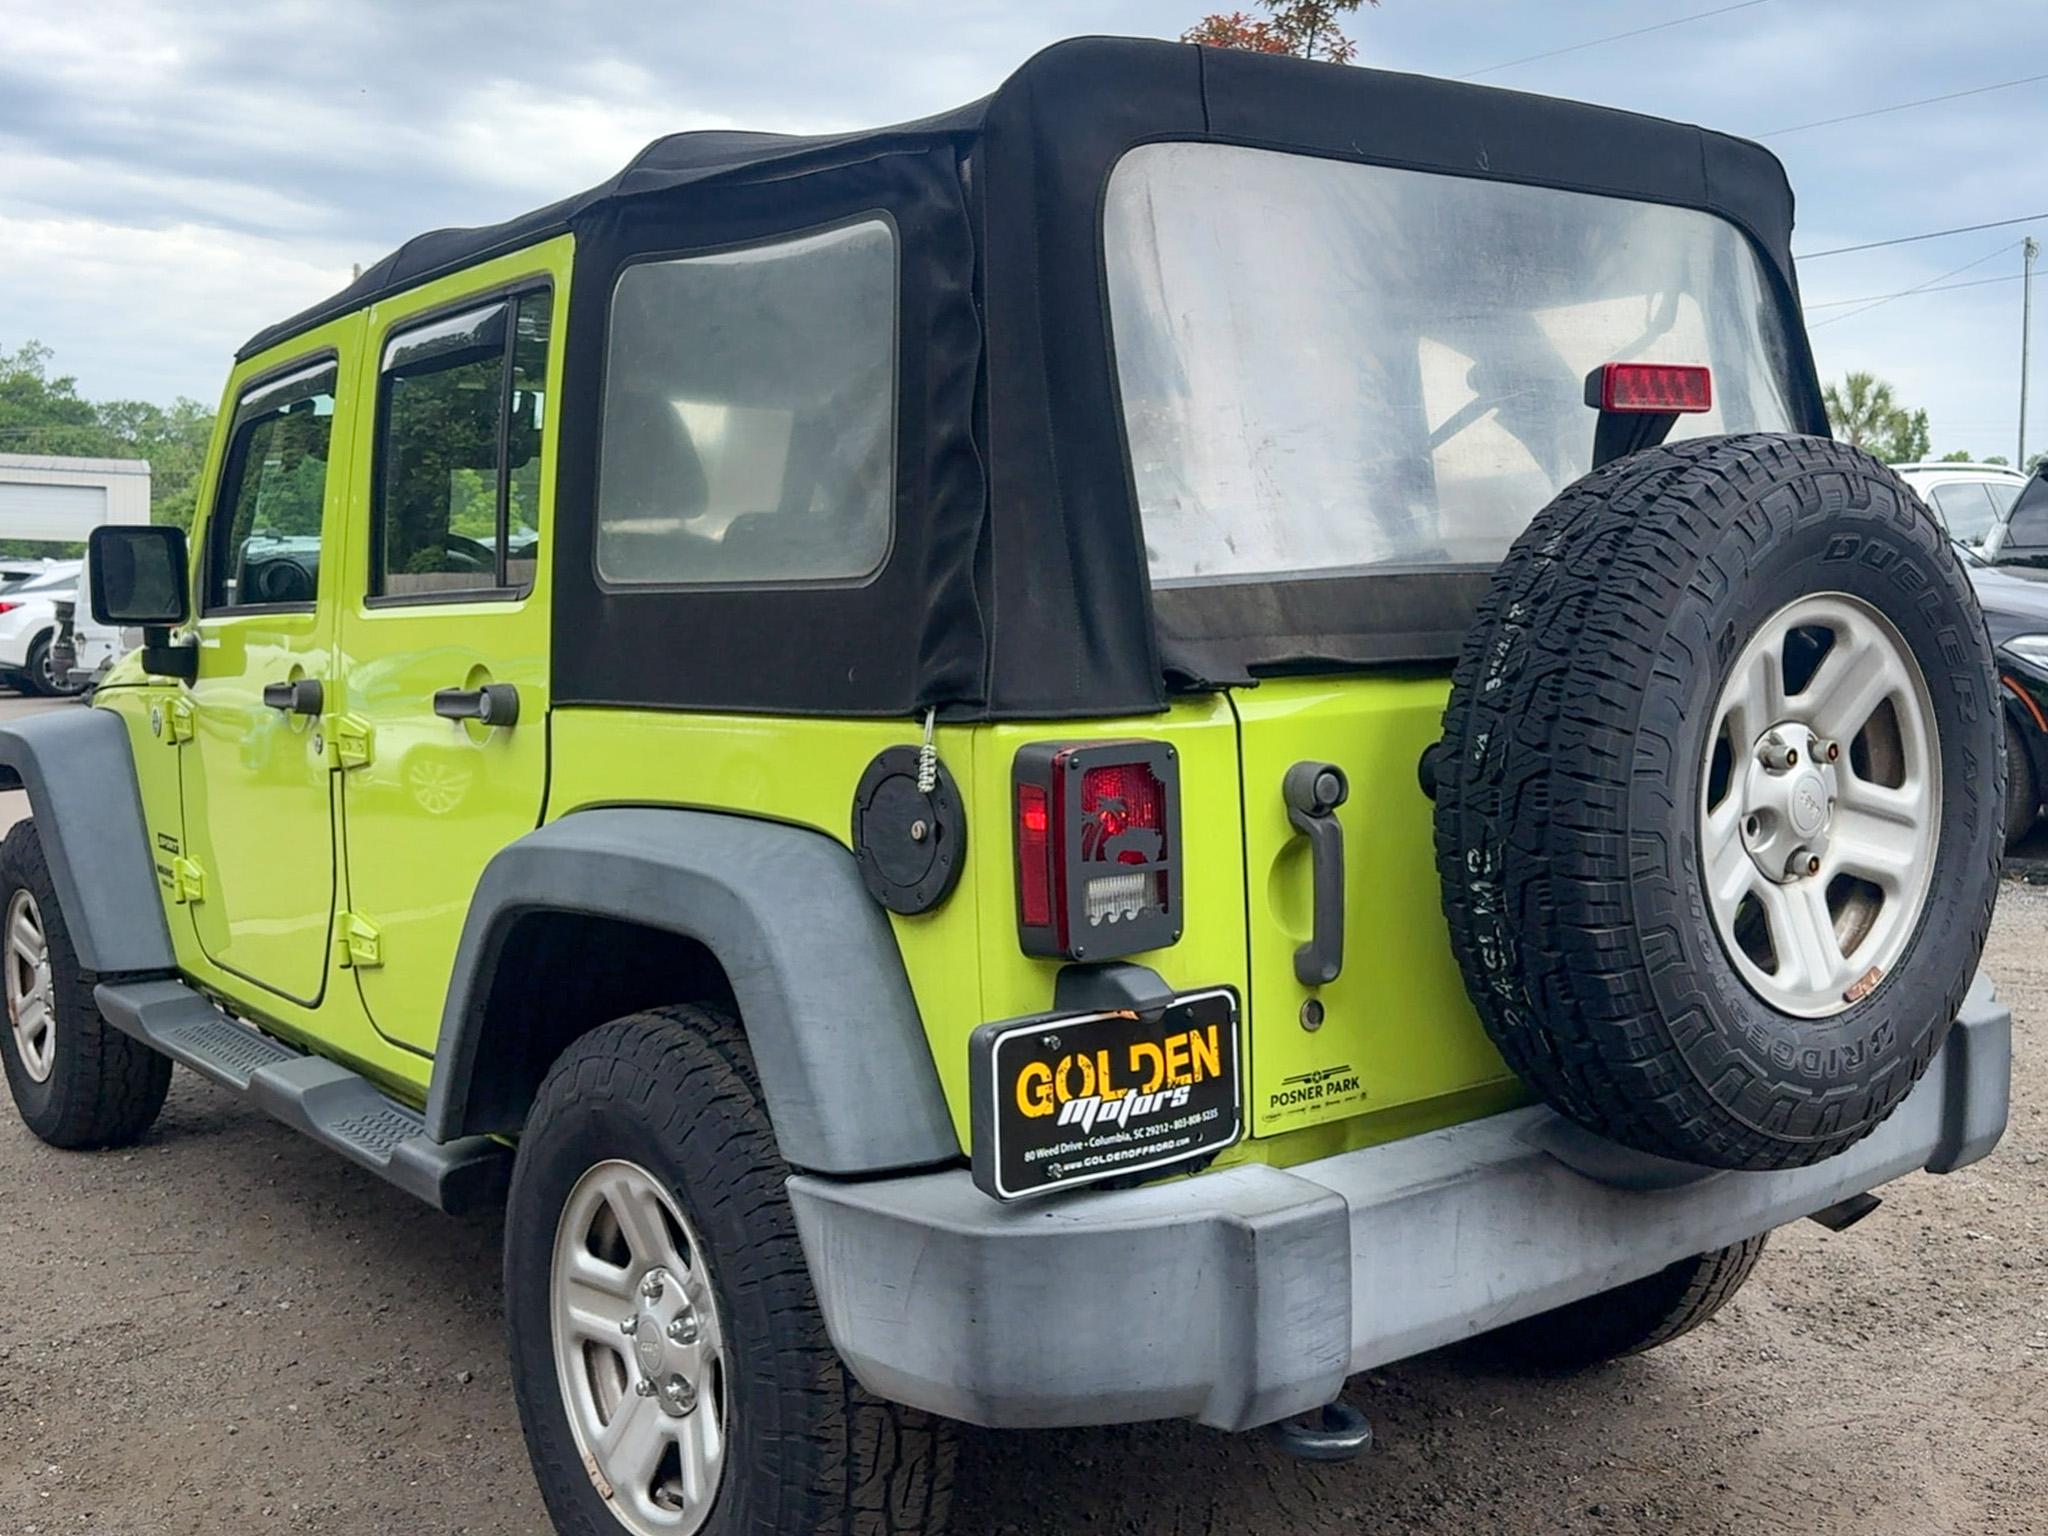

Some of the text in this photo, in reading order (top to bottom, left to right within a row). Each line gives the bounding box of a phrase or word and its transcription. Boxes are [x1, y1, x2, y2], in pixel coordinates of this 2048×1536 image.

[1819, 533, 1977, 723] DUELER
[1016, 1025, 1222, 1118] GOLDEN
[1270, 1085, 1323, 1108] POSNER
[1326, 1077, 1360, 1095] PARK
[1024, 1151, 1036, 1162] 80
[1036, 1144, 1060, 1158] Weed
[1061, 1141, 1083, 1153] Drive
[1089, 1132, 1132, 1147] Columbia,
[1133, 1128, 1144, 1139] SC
[1145, 1123, 1169, 1137] 29212
